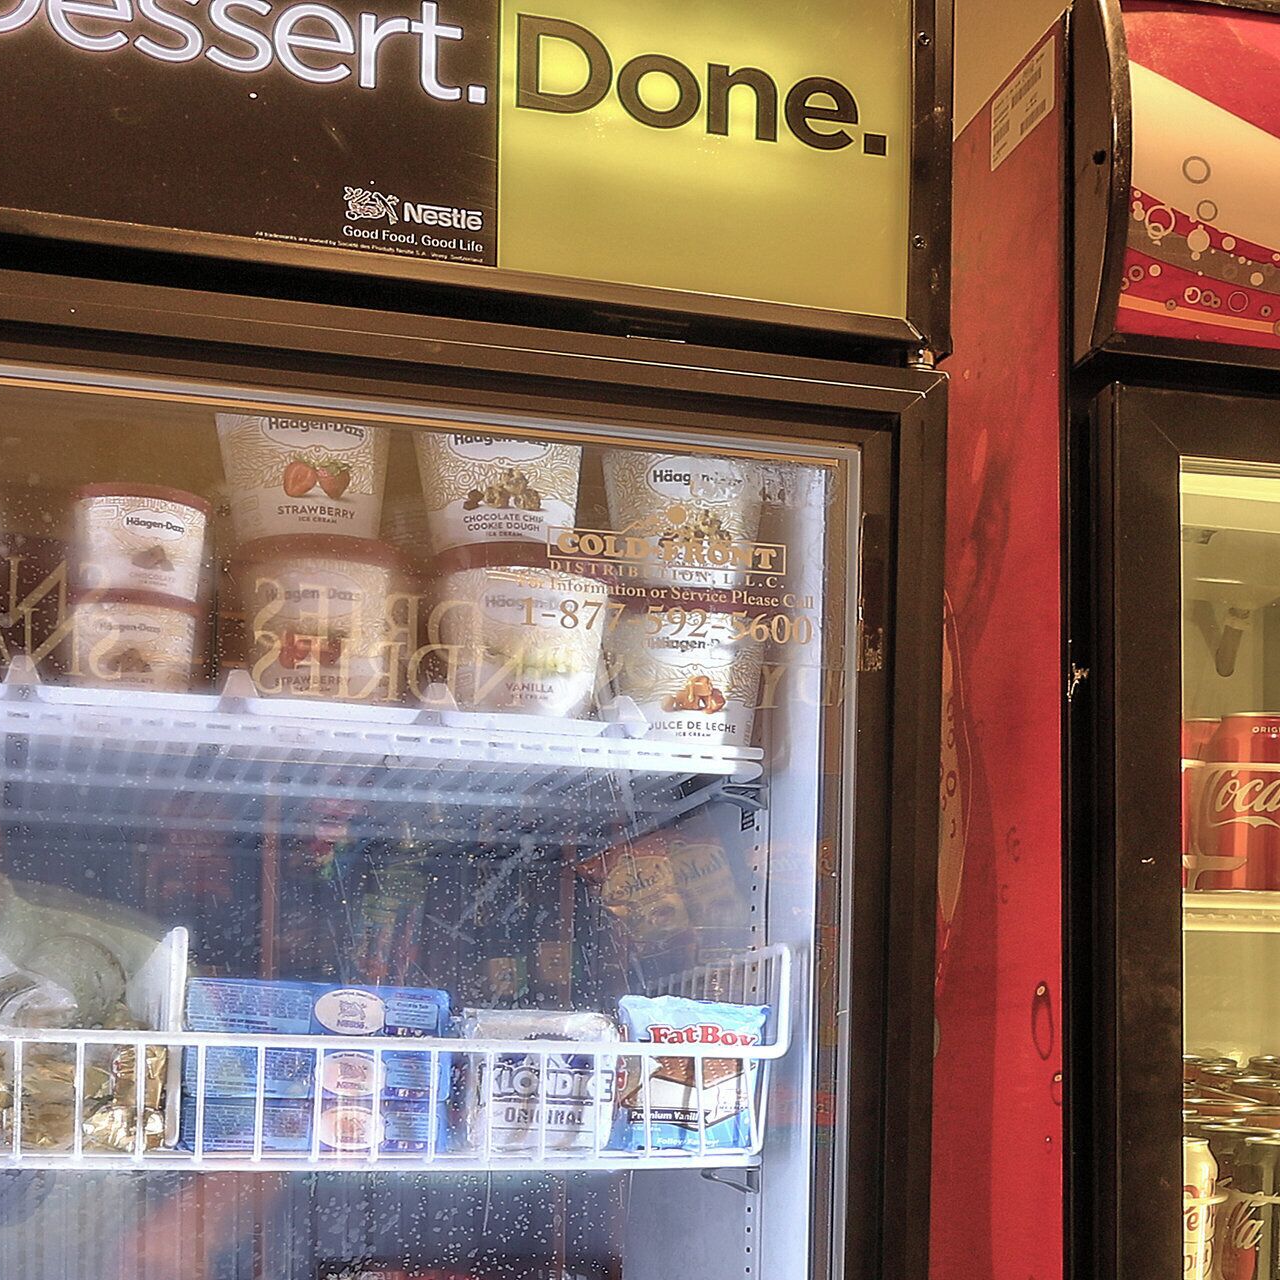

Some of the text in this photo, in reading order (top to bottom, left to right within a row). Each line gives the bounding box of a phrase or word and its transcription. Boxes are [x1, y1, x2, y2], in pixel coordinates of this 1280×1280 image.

[515, 13, 888, 156] Done.
[342, 225, 379, 240] Good
[421, 234, 456, 249] Good
[459, 239, 483, 253] Life
[278, 505, 356, 519] STRAWBERRY
[463, 513, 520, 524] CHOCOLATE
[126, 516, 185, 534] Häagen-Dazs
[467, 523, 540, 532] COOKIE DOUGH
[550, 579, 779, 607] Information or Service Please
[519, 597, 812, 644] 1-877-592-5600
[505, 682, 554, 694] VANILLA
[687, 721, 737, 735] DE LECHE
